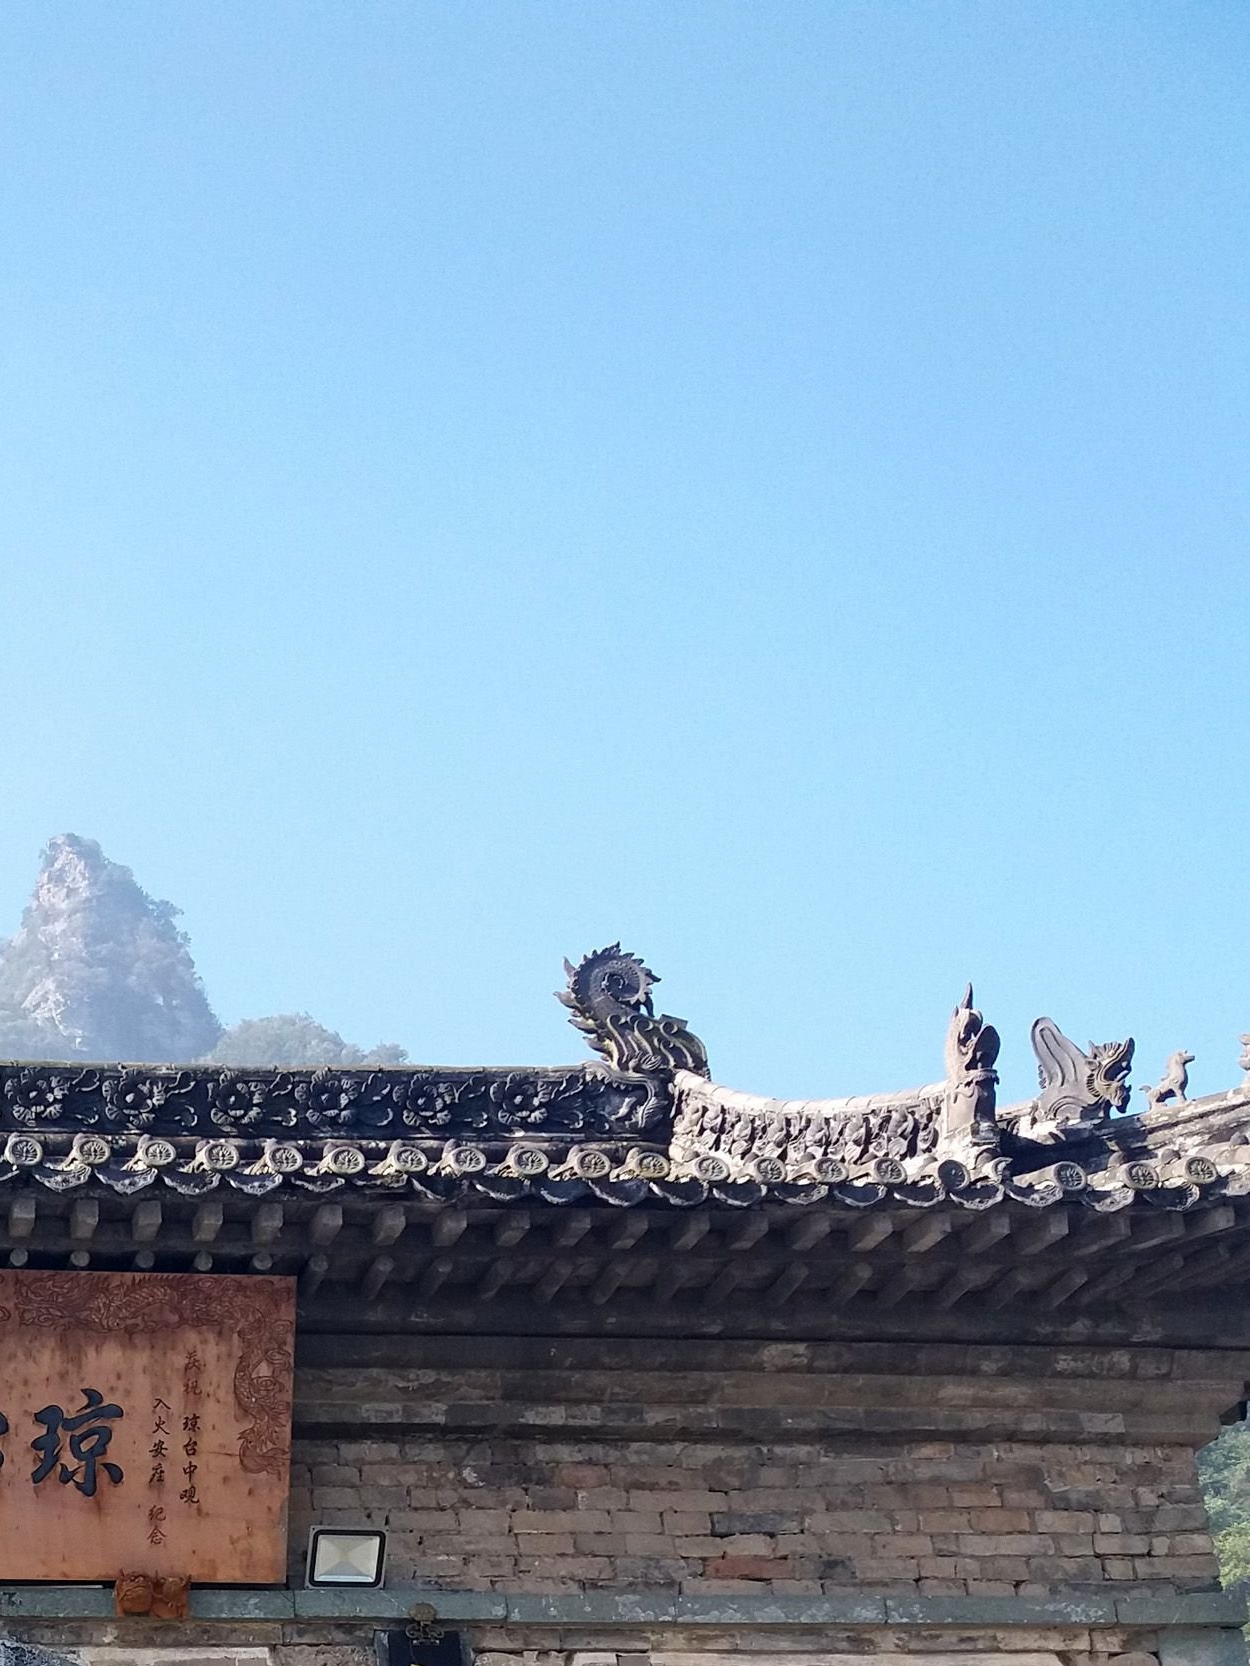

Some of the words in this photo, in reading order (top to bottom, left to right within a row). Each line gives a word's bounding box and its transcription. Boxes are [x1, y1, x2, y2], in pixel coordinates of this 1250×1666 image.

[180, 1413, 201, 1504] 琼台中观
[146, 1505, 168, 1546] 纪念
